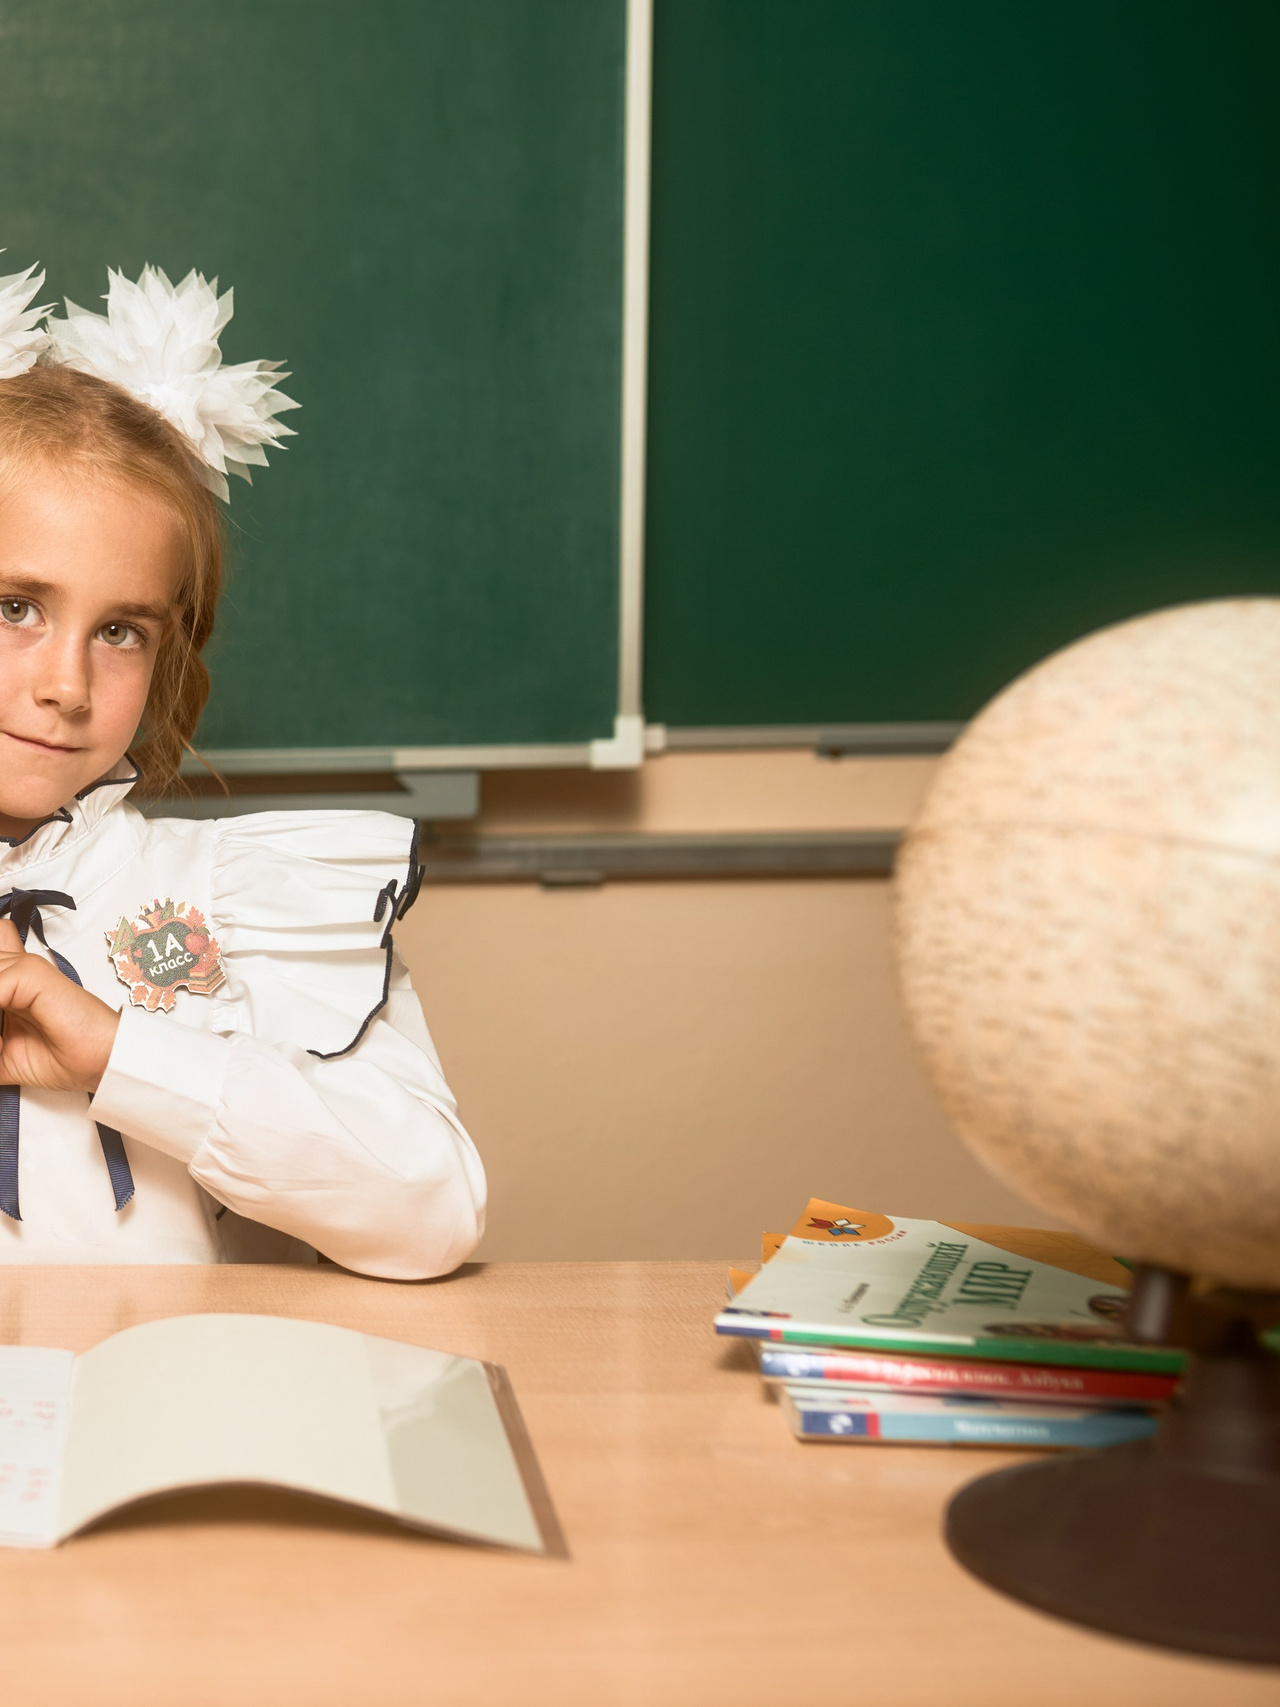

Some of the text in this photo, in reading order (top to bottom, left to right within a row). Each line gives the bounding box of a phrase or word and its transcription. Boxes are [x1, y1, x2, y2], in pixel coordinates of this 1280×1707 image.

[147, 933, 184, 962] 1А
[149, 952, 193, 976] класс
[952, 1261, 1034, 1312] МИР
